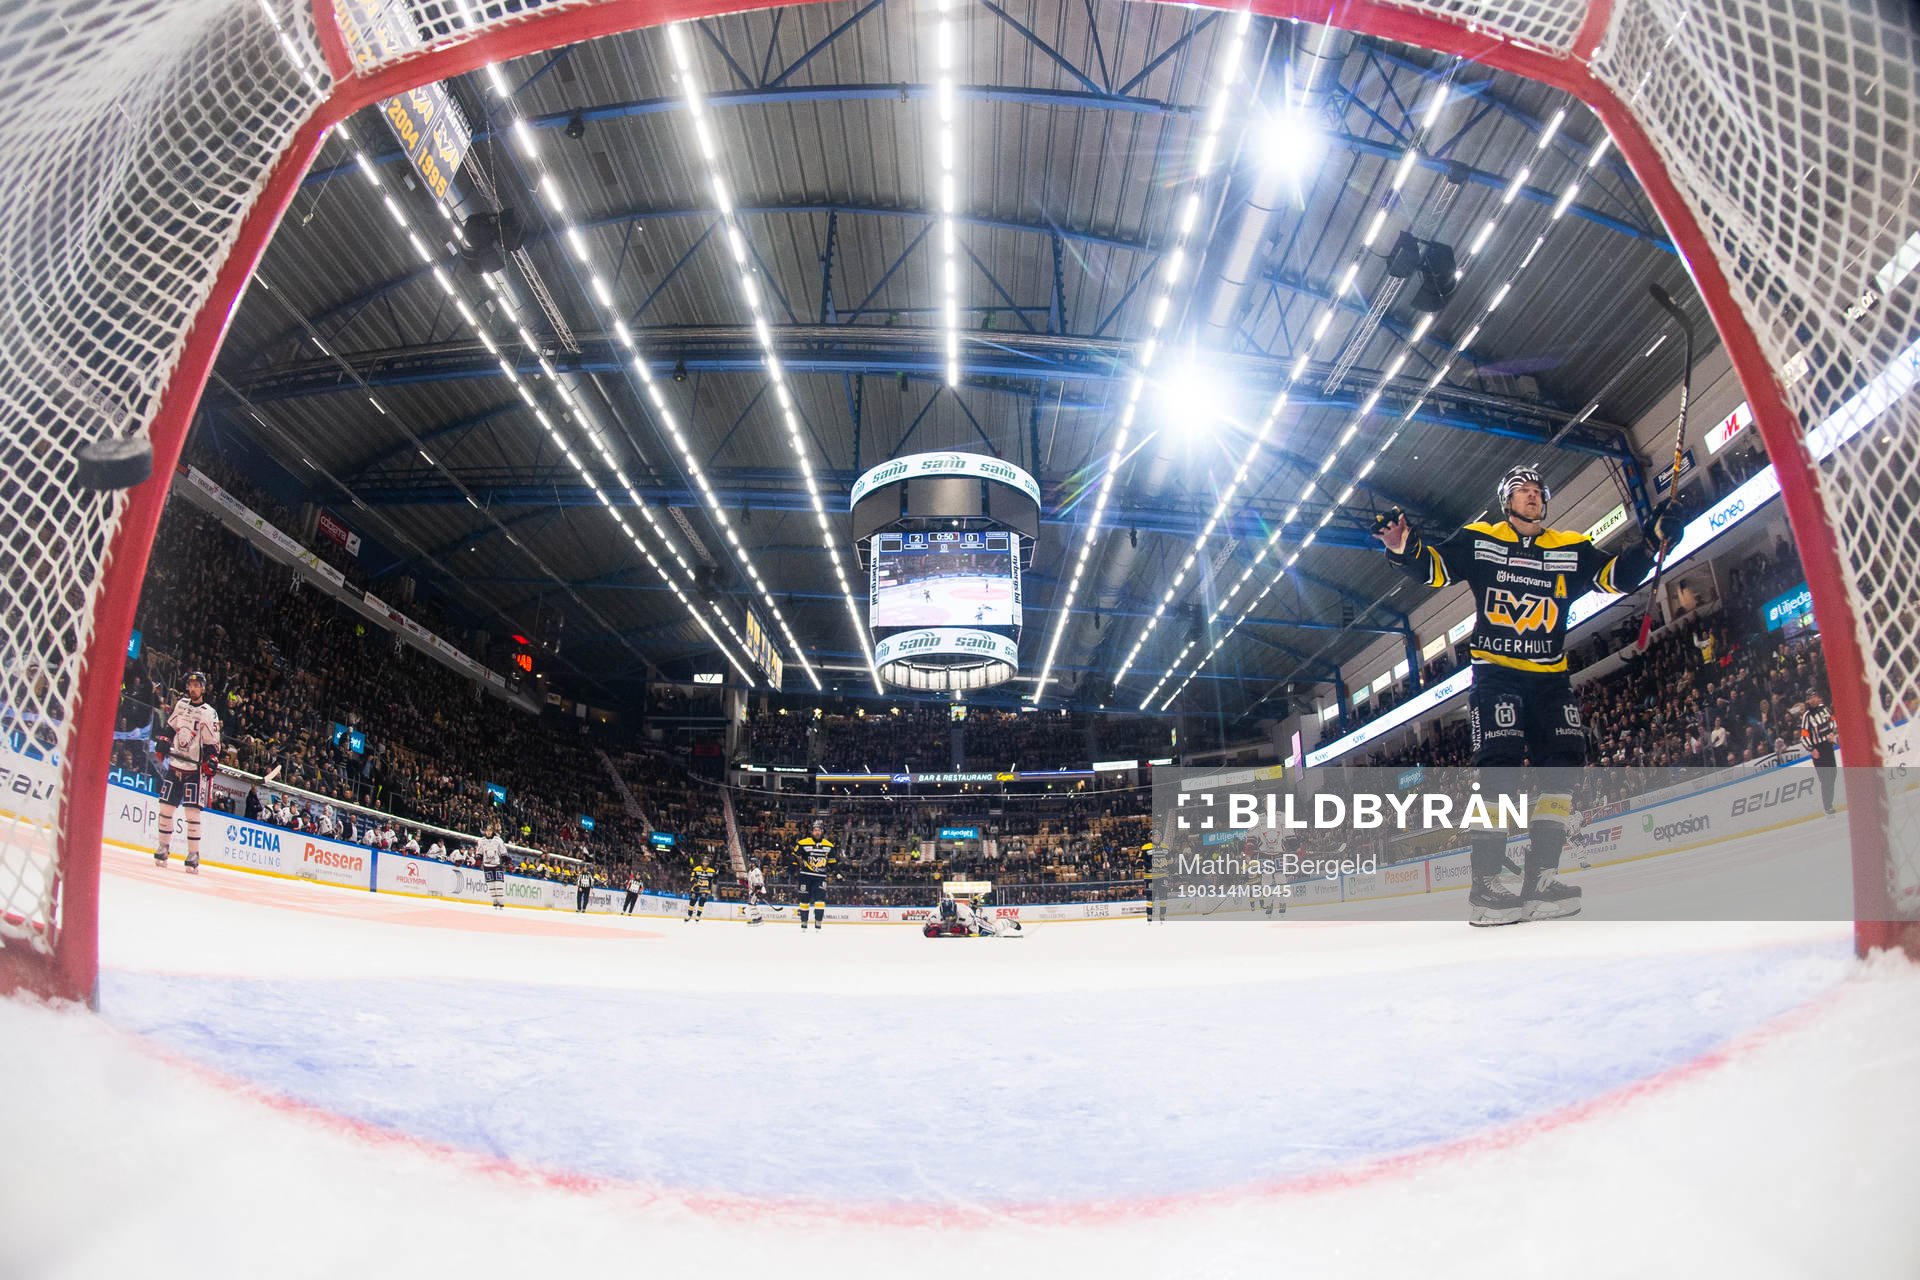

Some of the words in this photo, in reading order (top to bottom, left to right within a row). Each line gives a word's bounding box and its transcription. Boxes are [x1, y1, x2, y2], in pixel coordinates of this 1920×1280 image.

[388, 98, 419, 151] 2004
[418, 147, 448, 197] 1995
[1595, 511, 1623, 536] AXELENT
[1709, 499, 1745, 531] Koneo
[1506, 573, 1552, 588] Husqvarna
[1555, 574, 1567, 599] A
[1478, 635, 1552, 653] FAGERHULT
[943, 773, 993, 781] RESTAURANG
[1731, 777, 1815, 817] BAUER
[239, 827, 281, 853] STENA
[225, 846, 281, 868] RECYCLING
[303, 843, 363, 871] Passera
[466, 877, 488, 893] Hydro
[1385, 868, 1419, 884] Passera
[862, 911, 888, 919] JULA
[996, 908, 1019, 916] SEW
